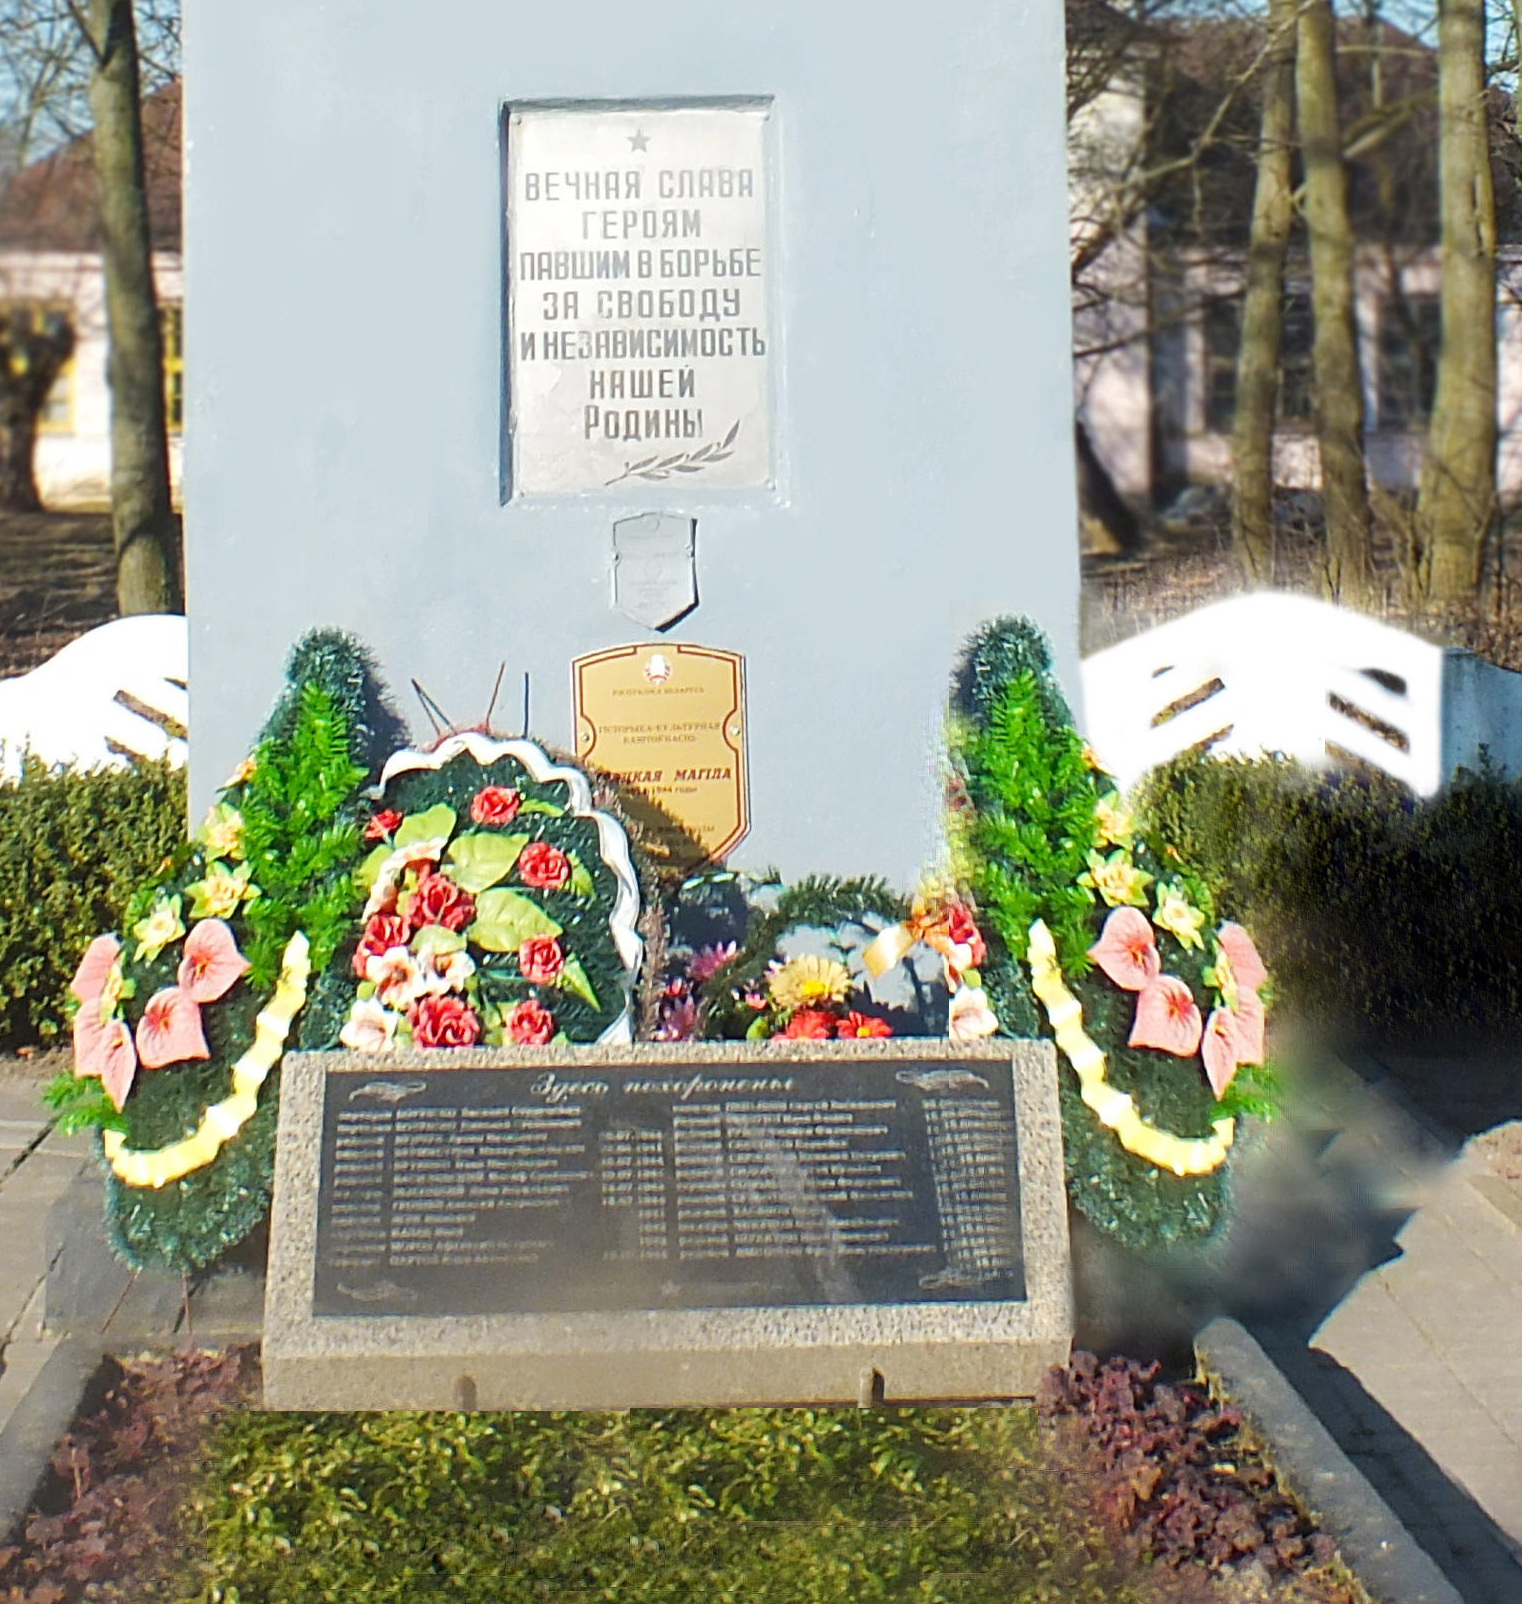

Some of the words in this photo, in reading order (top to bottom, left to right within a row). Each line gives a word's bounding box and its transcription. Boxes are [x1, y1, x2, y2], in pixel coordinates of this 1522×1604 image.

[525, 171, 640, 201] ВЕЧНАЯ
[658, 169, 753, 198] СЛАВА
[582, 209, 701, 240] ГЕРОЯМ
[520, 250, 630, 280] ПАВШИМ
[637, 249, 652, 278] В
[660, 248, 761, 278] БОРЬБЕ
[543, 290, 578, 320] ЗА
[597, 288, 740, 322] СВОБОДУ
[520, 331, 536, 361] И
[543, 327, 765, 360] НЕЗАВИСИМОСТЬ
[590, 364, 695, 399] НАШЕЙ
[674, 767, 732, 782] МАГІЛА
